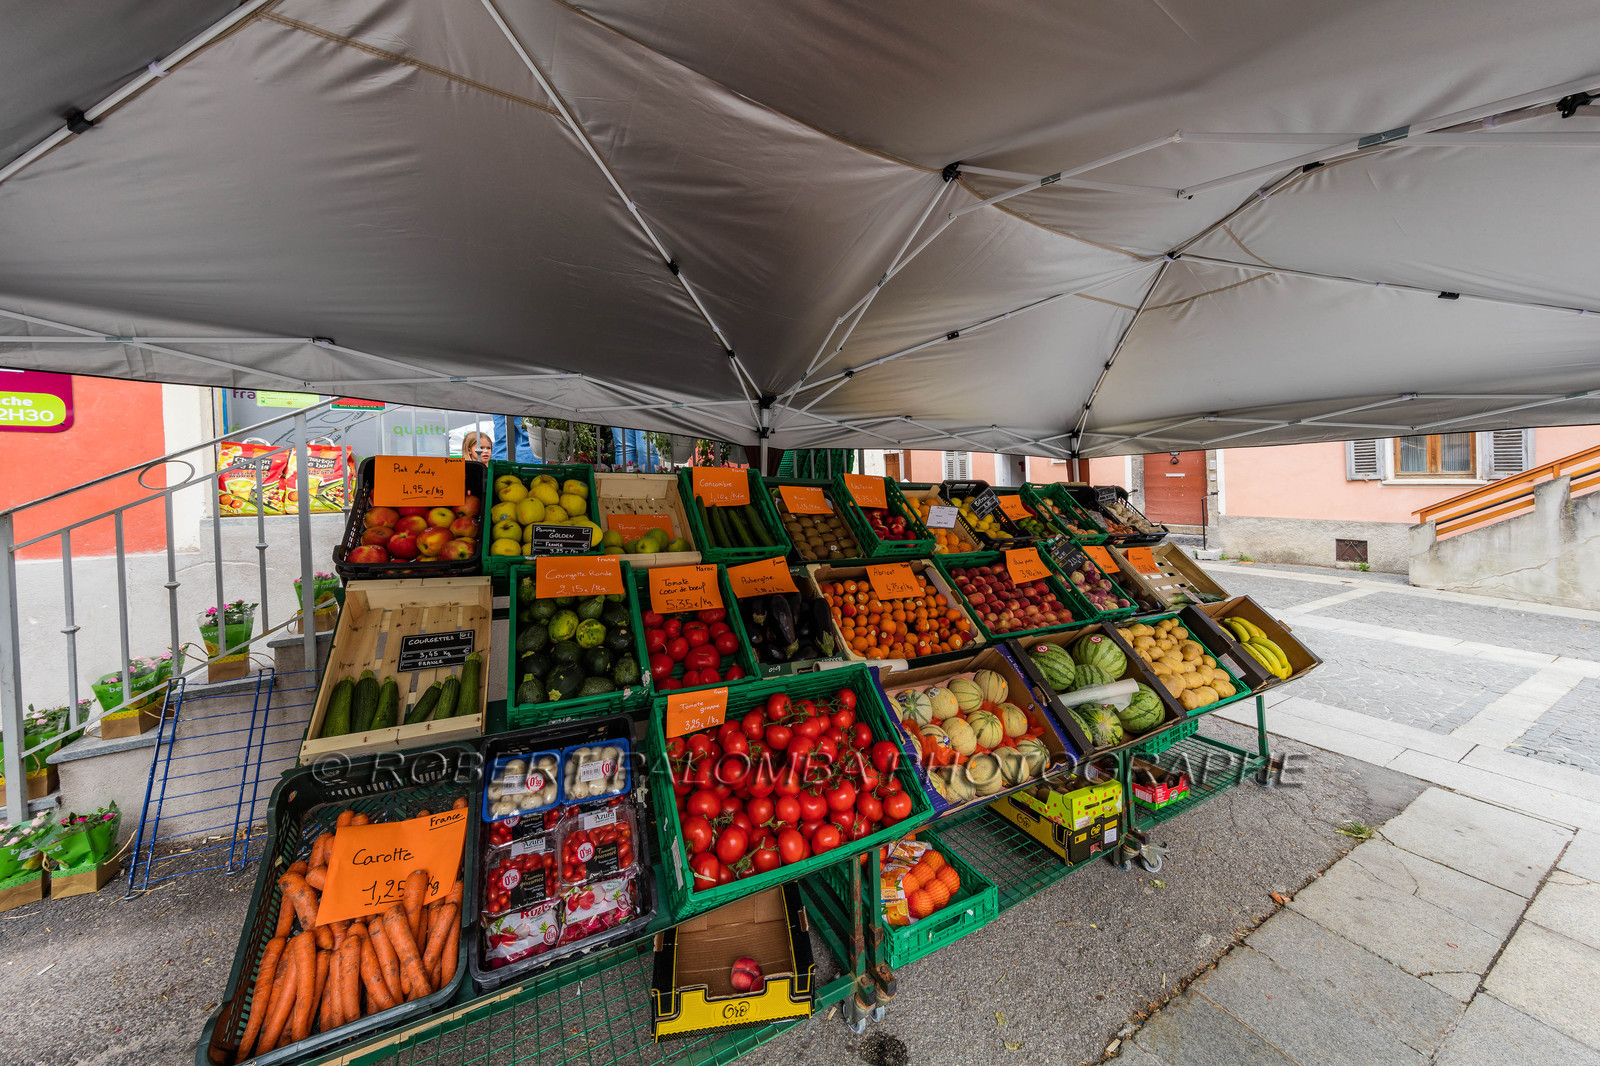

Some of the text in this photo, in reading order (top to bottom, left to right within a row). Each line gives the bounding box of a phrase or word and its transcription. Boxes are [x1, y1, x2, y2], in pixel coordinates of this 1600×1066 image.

[0, 396, 33, 406] che
[393, 463, 435, 476] Pink Lady
[408, 636, 455, 646] COURGETTES
[420, 651, 439, 659] 3,45
[418, 659, 444, 667] FRANCE
[680, 702, 704, 710] Tomate
[429, 812, 463, 828] France
[352, 848, 415, 866] Carotte
